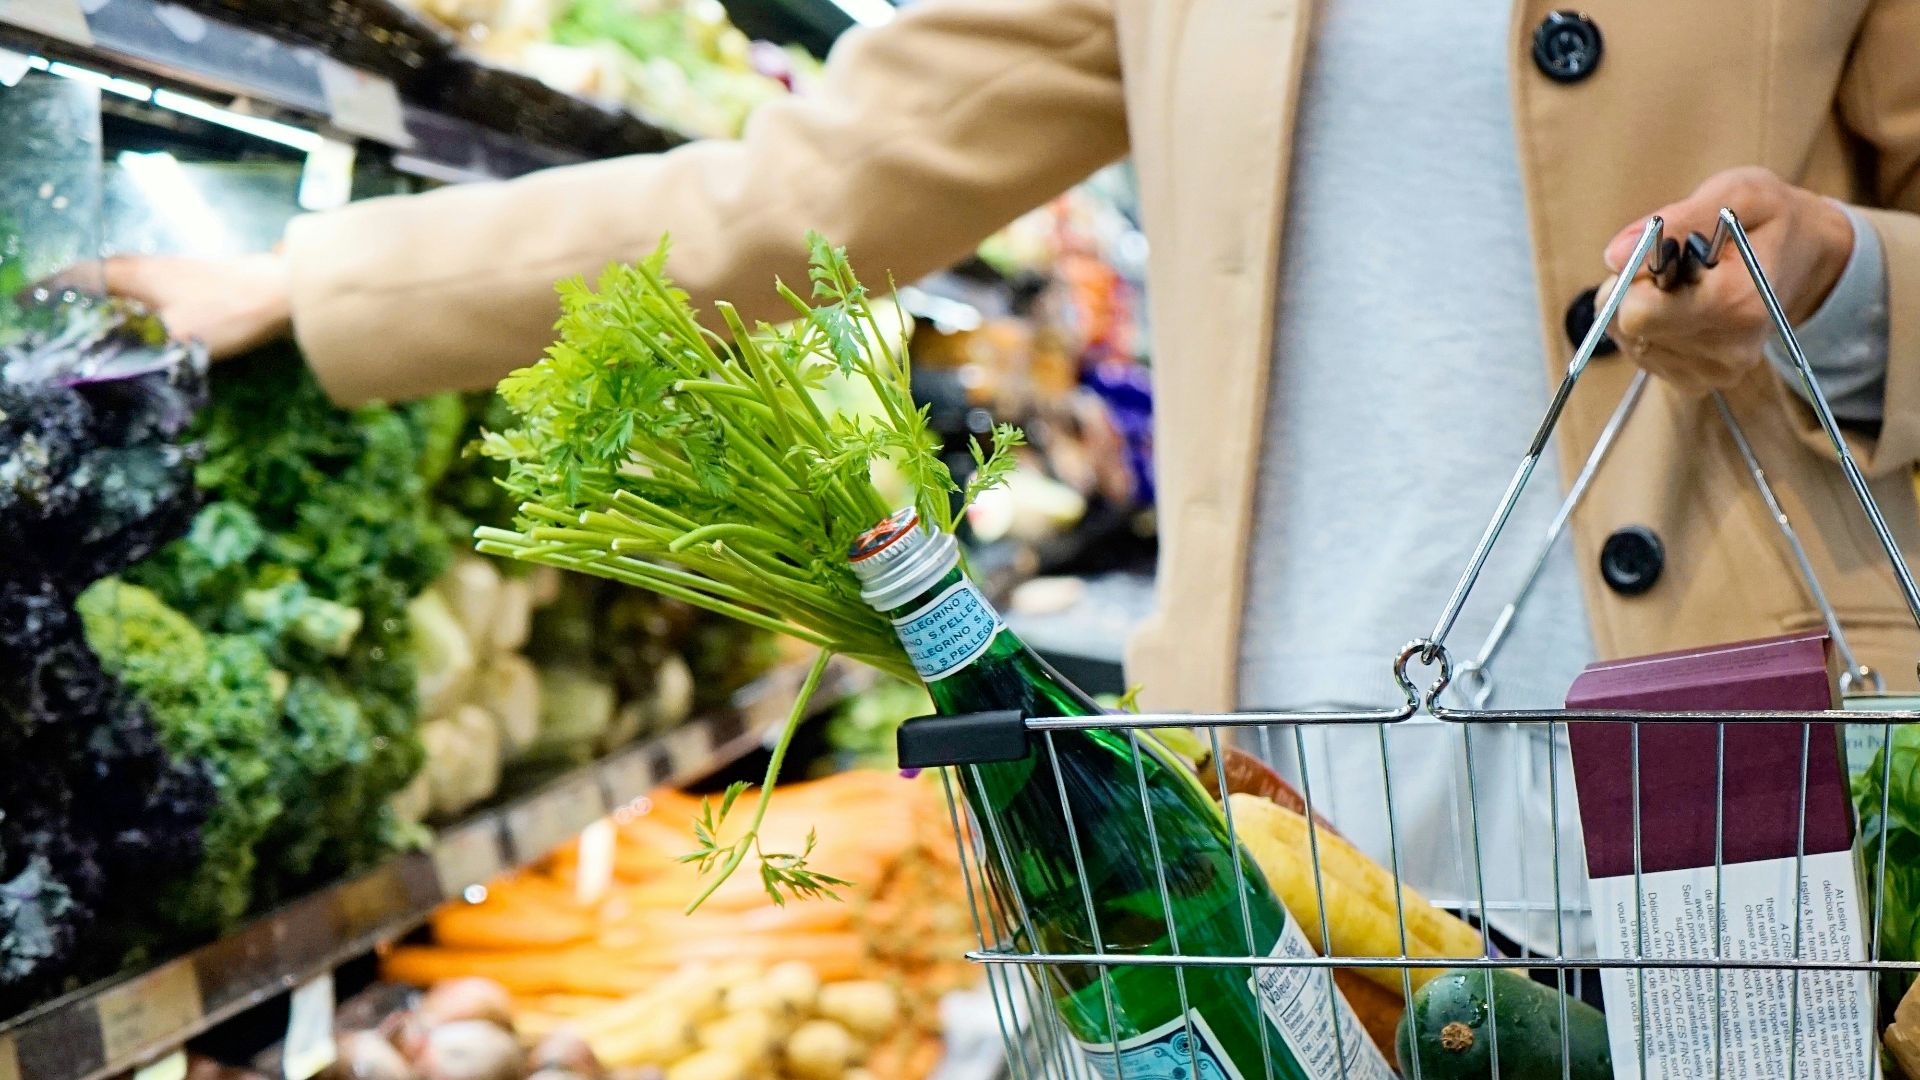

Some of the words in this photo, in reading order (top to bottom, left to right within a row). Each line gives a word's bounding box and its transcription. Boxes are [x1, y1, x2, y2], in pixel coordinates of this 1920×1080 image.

[1682, 884, 1693, 907] Seul
[1798, 874, 1811, 906] Lesley
[1822, 879, 1835, 921] delicious
[1835, 888, 1844, 899] At
[1616, 901, 1626, 924] vous
[1685, 908, 1693, 919] un
[1694, 897, 1704, 921] avec
[1717, 902, 1729, 933] Lesley
[1755, 903, 1765, 919] but
[1765, 897, 1776, 923] these
[1835, 901, 1847, 931] Lesley
[1620, 926, 1627, 939] ne
[1696, 922, 1707, 945] soin,
[1744, 904, 1756, 939] cheese
[1779, 922, 1788, 930] A
[1805, 918, 1814, 934] her
[1638, 909, 1656, 975] accompags
[1654, 937, 1661, 949] au
[1685, 921, 1698, 954] produit
[1749, 941, 1757, 951] or
[1756, 921, 1768, 947] really
[1768, 926, 1780, 958] unique
[1781, 932, 1792, 960] CRIS
[1818, 931, 1826, 946] are
[1664, 930, 1679, 982] CRAEZ
[1701, 947, 1708, 959] en
[1721, 935, 1732, 959] Stow
[1738, 938, 1747, 960] sna
[1807, 936, 1817, 961] team
[1840, 934, 1852, 961] Stow
[1655, 950, 1668, 986] nrel,
[1704, 889, 1713, 901] de
[1720, 1009, 1734, 1048] fabuleux
[1761, 948, 1771, 974] she
[1820, 948, 1830, 975] me
[1831, 948, 1843, 978] The
[1649, 976, 1658, 989] de
[1681, 968, 1694, 1002] pouvait
[1692, 957, 1703, 990] ison
[1704, 967, 1714, 993] etites
[1775, 968, 1786, 999] ackers
[1626, 978, 1636, 998] plus
[1661, 988, 1669, 1005] ces
[1671, 983, 1683, 1015] POUR
[1745, 991, 1753, 999] &
[1765, 975, 1775, 1001] when
[1802, 976, 1813, 1010] scratch
[1814, 988, 1823, 1003] the
[1824, 977, 1835, 997] with
[1629, 999, 1639, 1023] vous
[1729, 989, 1741, 1019] Foods
[1746, 1001, 1754, 1017] are
[1757, 999, 1767, 1015] We
[1779, 1001, 1787, 1017] are
[1827, 999, 1836, 1020] care
[1835, 980, 1848, 1019] fabulous
[1848, 990, 1860, 1019] Foods
[1649, 991, 1665, 1038] trempette,
[1687, 1003, 1700, 1046] satisfaire
[1759, 1017, 1767, 1033] are
[1767, 1003, 1779, 1036] topped
[1786, 974, 1806, 1058] RSATION
[1805, 1013, 1816, 1038] using
[1815, 1006, 1826, 1025] only
[1662, 1006, 1677, 1054] craquelins
[1675, 1016, 1687, 1039] CES
[1733, 1020, 1744, 1048] adore
[1748, 1019, 1757, 1040] sure
[1818, 1027, 1828, 1046] way
[1830, 1022, 1838, 1032] in
[1838, 1021, 1851, 1050] crisps
[1852, 1021, 1860, 1035] we
[1644, 1033, 1656, 1059] nous,
[1657, 1039, 1667, 1054] de
[1679, 1040, 1690, 1065] FINS
[1701, 1032, 1711, 1055] avec
[1750, 1042, 1759, 1060] you
[1761, 1035, 1774, 1075] addicted
[1773, 1037, 1782, 1057] with
[1822, 1048, 1830, 1058] to
[1831, 1033, 1842, 1059] small
[1854, 1037, 1864, 1057] love
[1670, 1057, 1679, 1077] sont
[1692, 1048, 1704, 1079] Lesley
[1705, 1057, 1714, 1075] des
[1844, 1052, 1855, 1073] from
